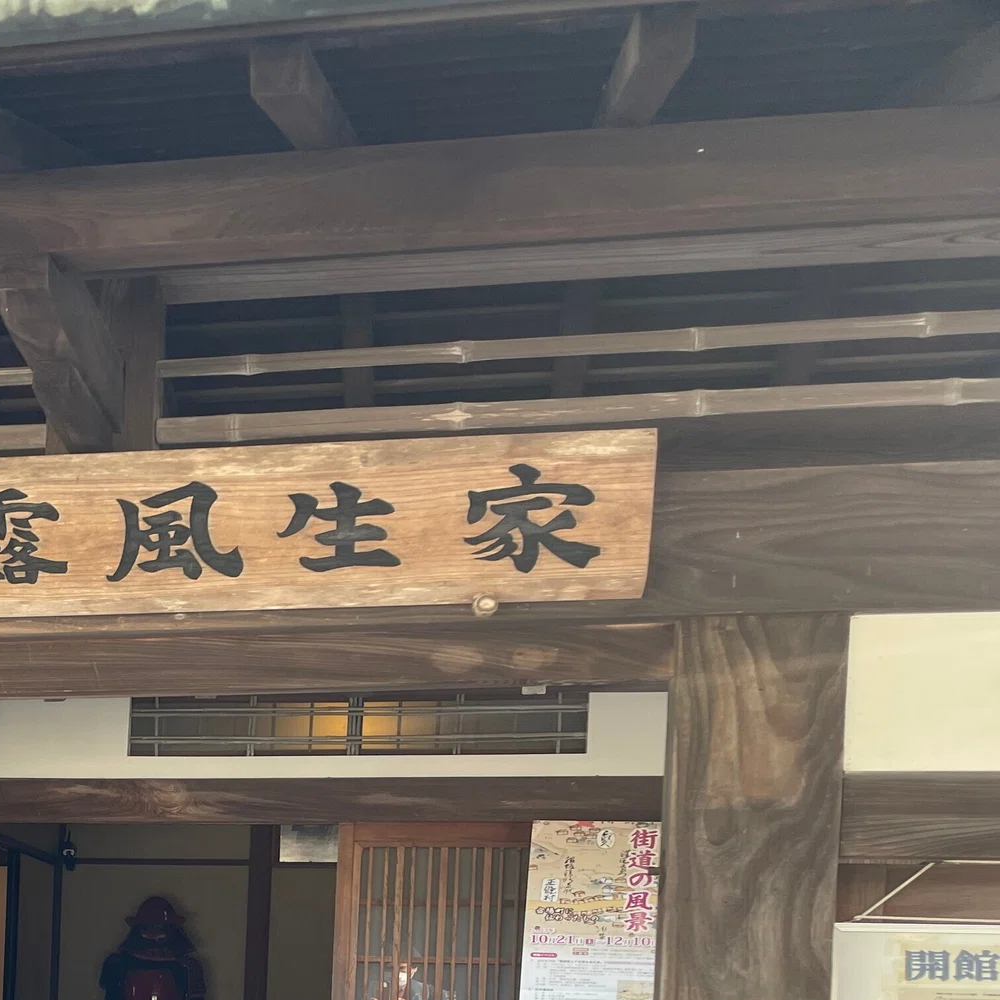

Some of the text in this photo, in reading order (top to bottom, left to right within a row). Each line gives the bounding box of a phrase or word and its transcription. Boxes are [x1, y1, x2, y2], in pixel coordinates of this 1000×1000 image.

[624, 829, 658, 932] 街道の風景
[905, 949, 1000, 982] 開館
